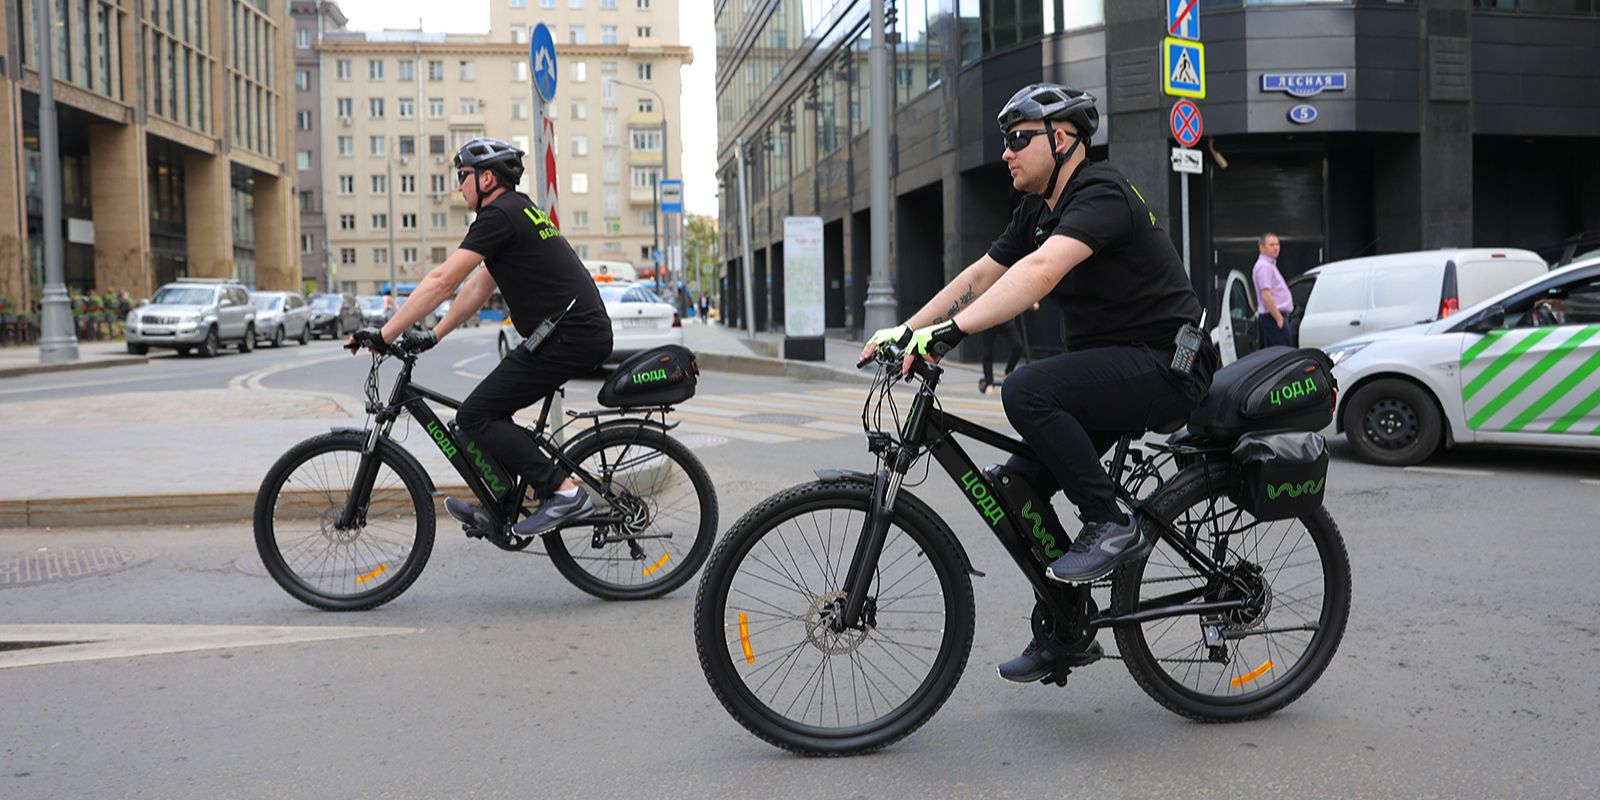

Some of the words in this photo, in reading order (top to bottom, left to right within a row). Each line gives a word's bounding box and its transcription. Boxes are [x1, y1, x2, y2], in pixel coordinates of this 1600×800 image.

[1279, 75, 1332, 87] ЛЕСНАЯ
[1300, 107, 1309, 120] 5
[632, 368, 667, 384] ЦОДД
[1270, 377, 1318, 405] ЦОДД
[426, 420, 458, 460] ЦОДД
[961, 469, 1006, 527] ЦОДД
